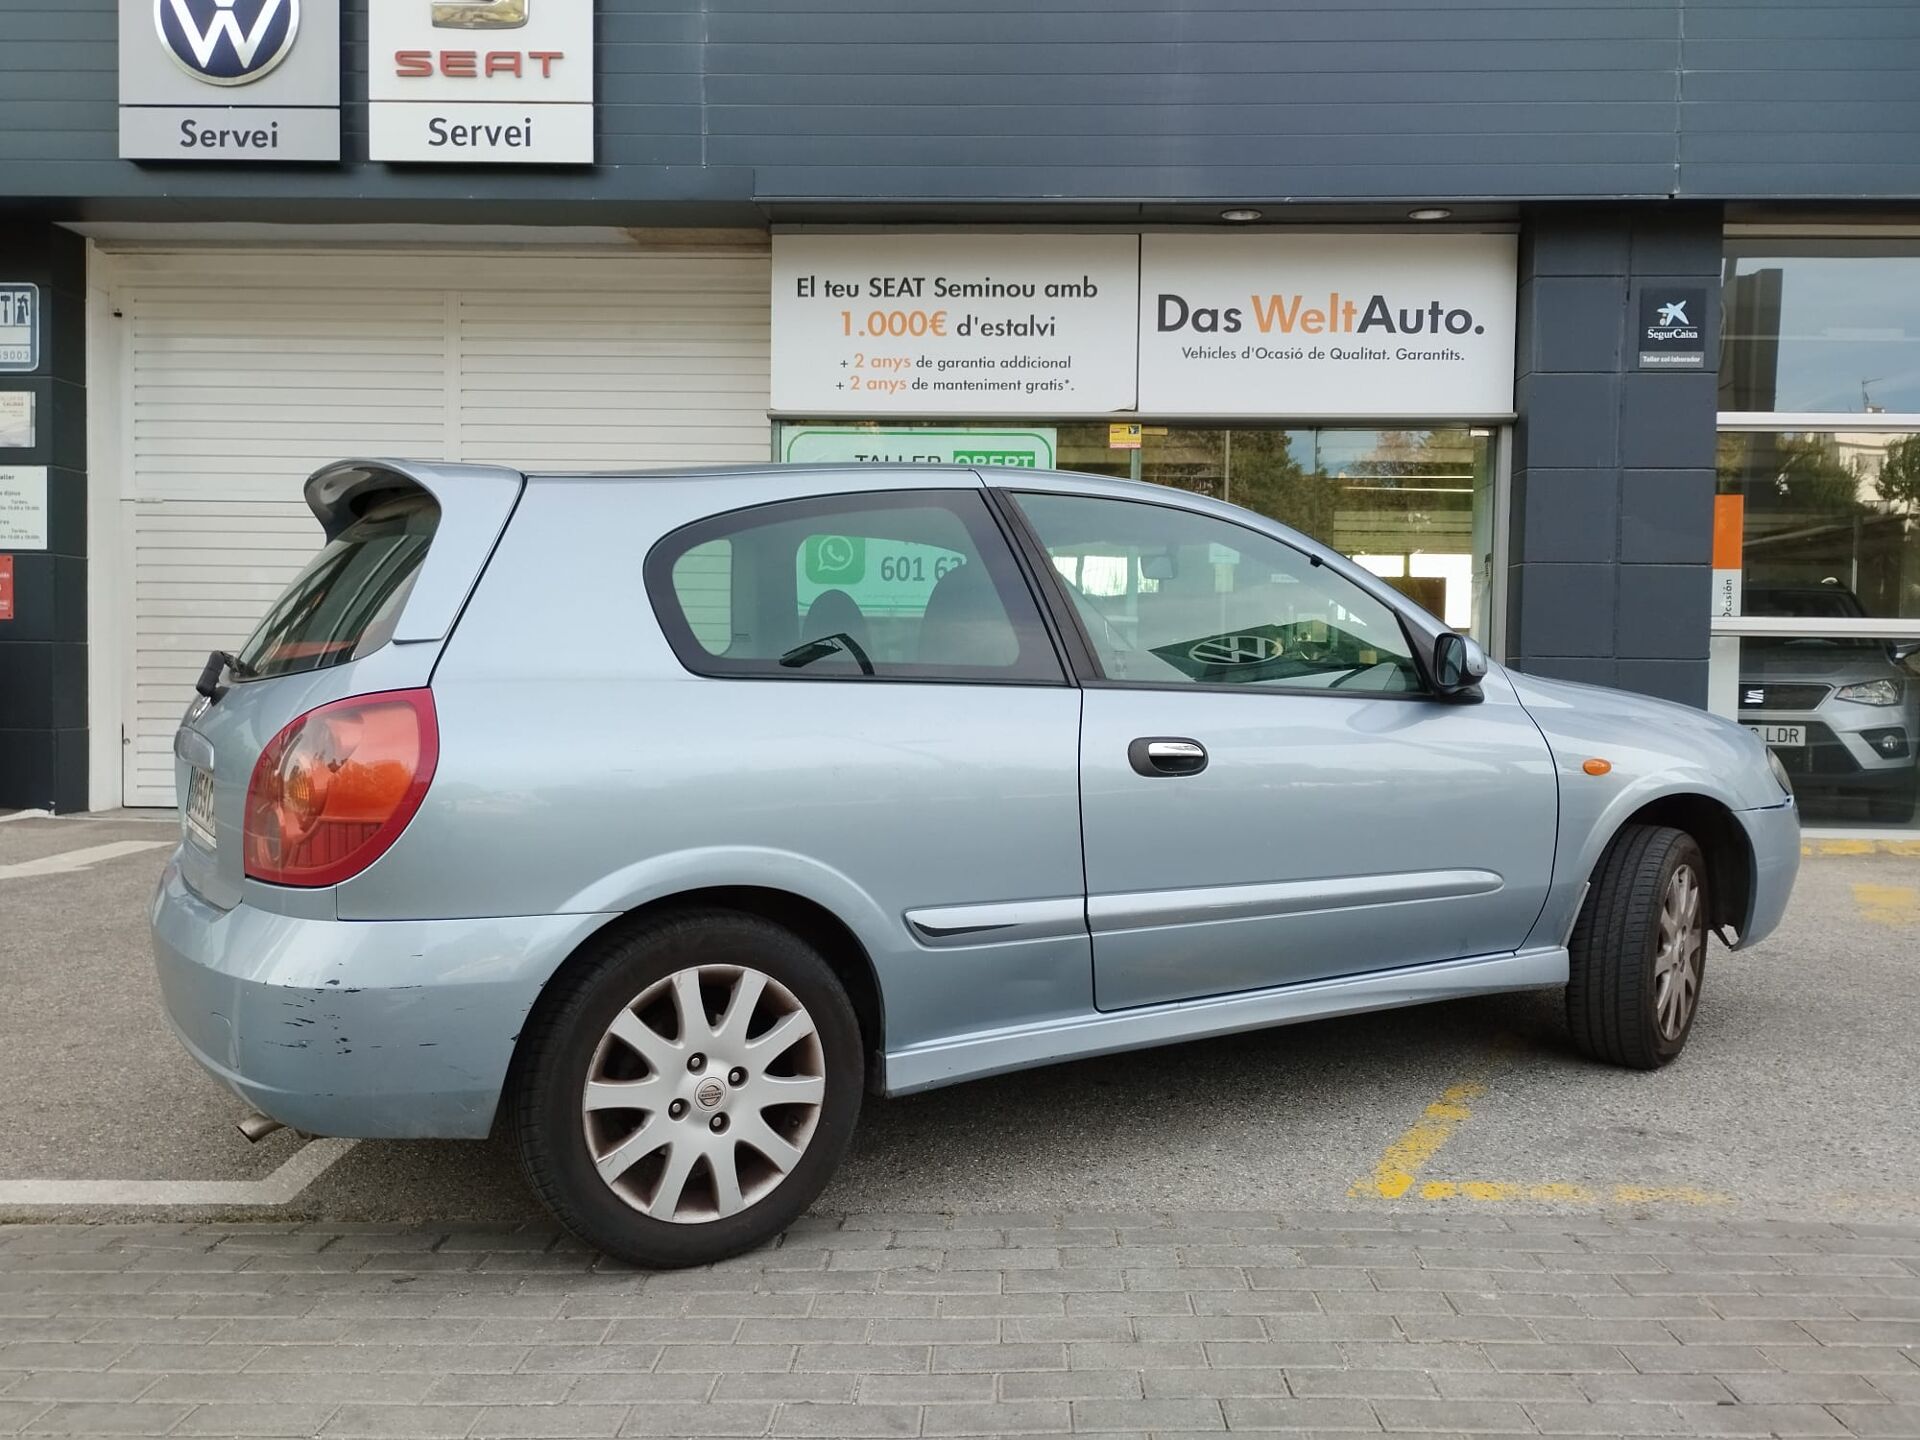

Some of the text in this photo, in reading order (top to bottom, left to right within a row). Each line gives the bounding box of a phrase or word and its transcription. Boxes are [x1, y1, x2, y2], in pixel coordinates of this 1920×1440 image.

[394, 50, 565, 79] SEAT
[180, 119, 279, 148] Servei
[427, 117, 532, 148] Servei
[796, 275, 1099, 299] El teu SEAT Seminou amb
[841, 311, 1056, 338] 1.000€ d'estalvi
[1157, 293, 1486, 337] Das WeltAuto.
[1647, 328, 1699, 341] SegurCaixa
[853, 353, 865, 369] 2
[870, 357, 911, 373] anys
[915, 355, 933, 369] de
[937, 356, 996, 372] garantia
[999, 354, 1072, 369] addicional
[1181, 346, 1465, 361] Vehicles d'Ocasió de Qualitat. Garantits.
[849, 376, 861, 391] 2
[866, 380, 907, 395] anys
[911, 377, 929, 391] de
[933, 378, 1022, 391] manteniment
[880, 555, 926, 583] 601
[1766, 727, 1799, 743] LDR
